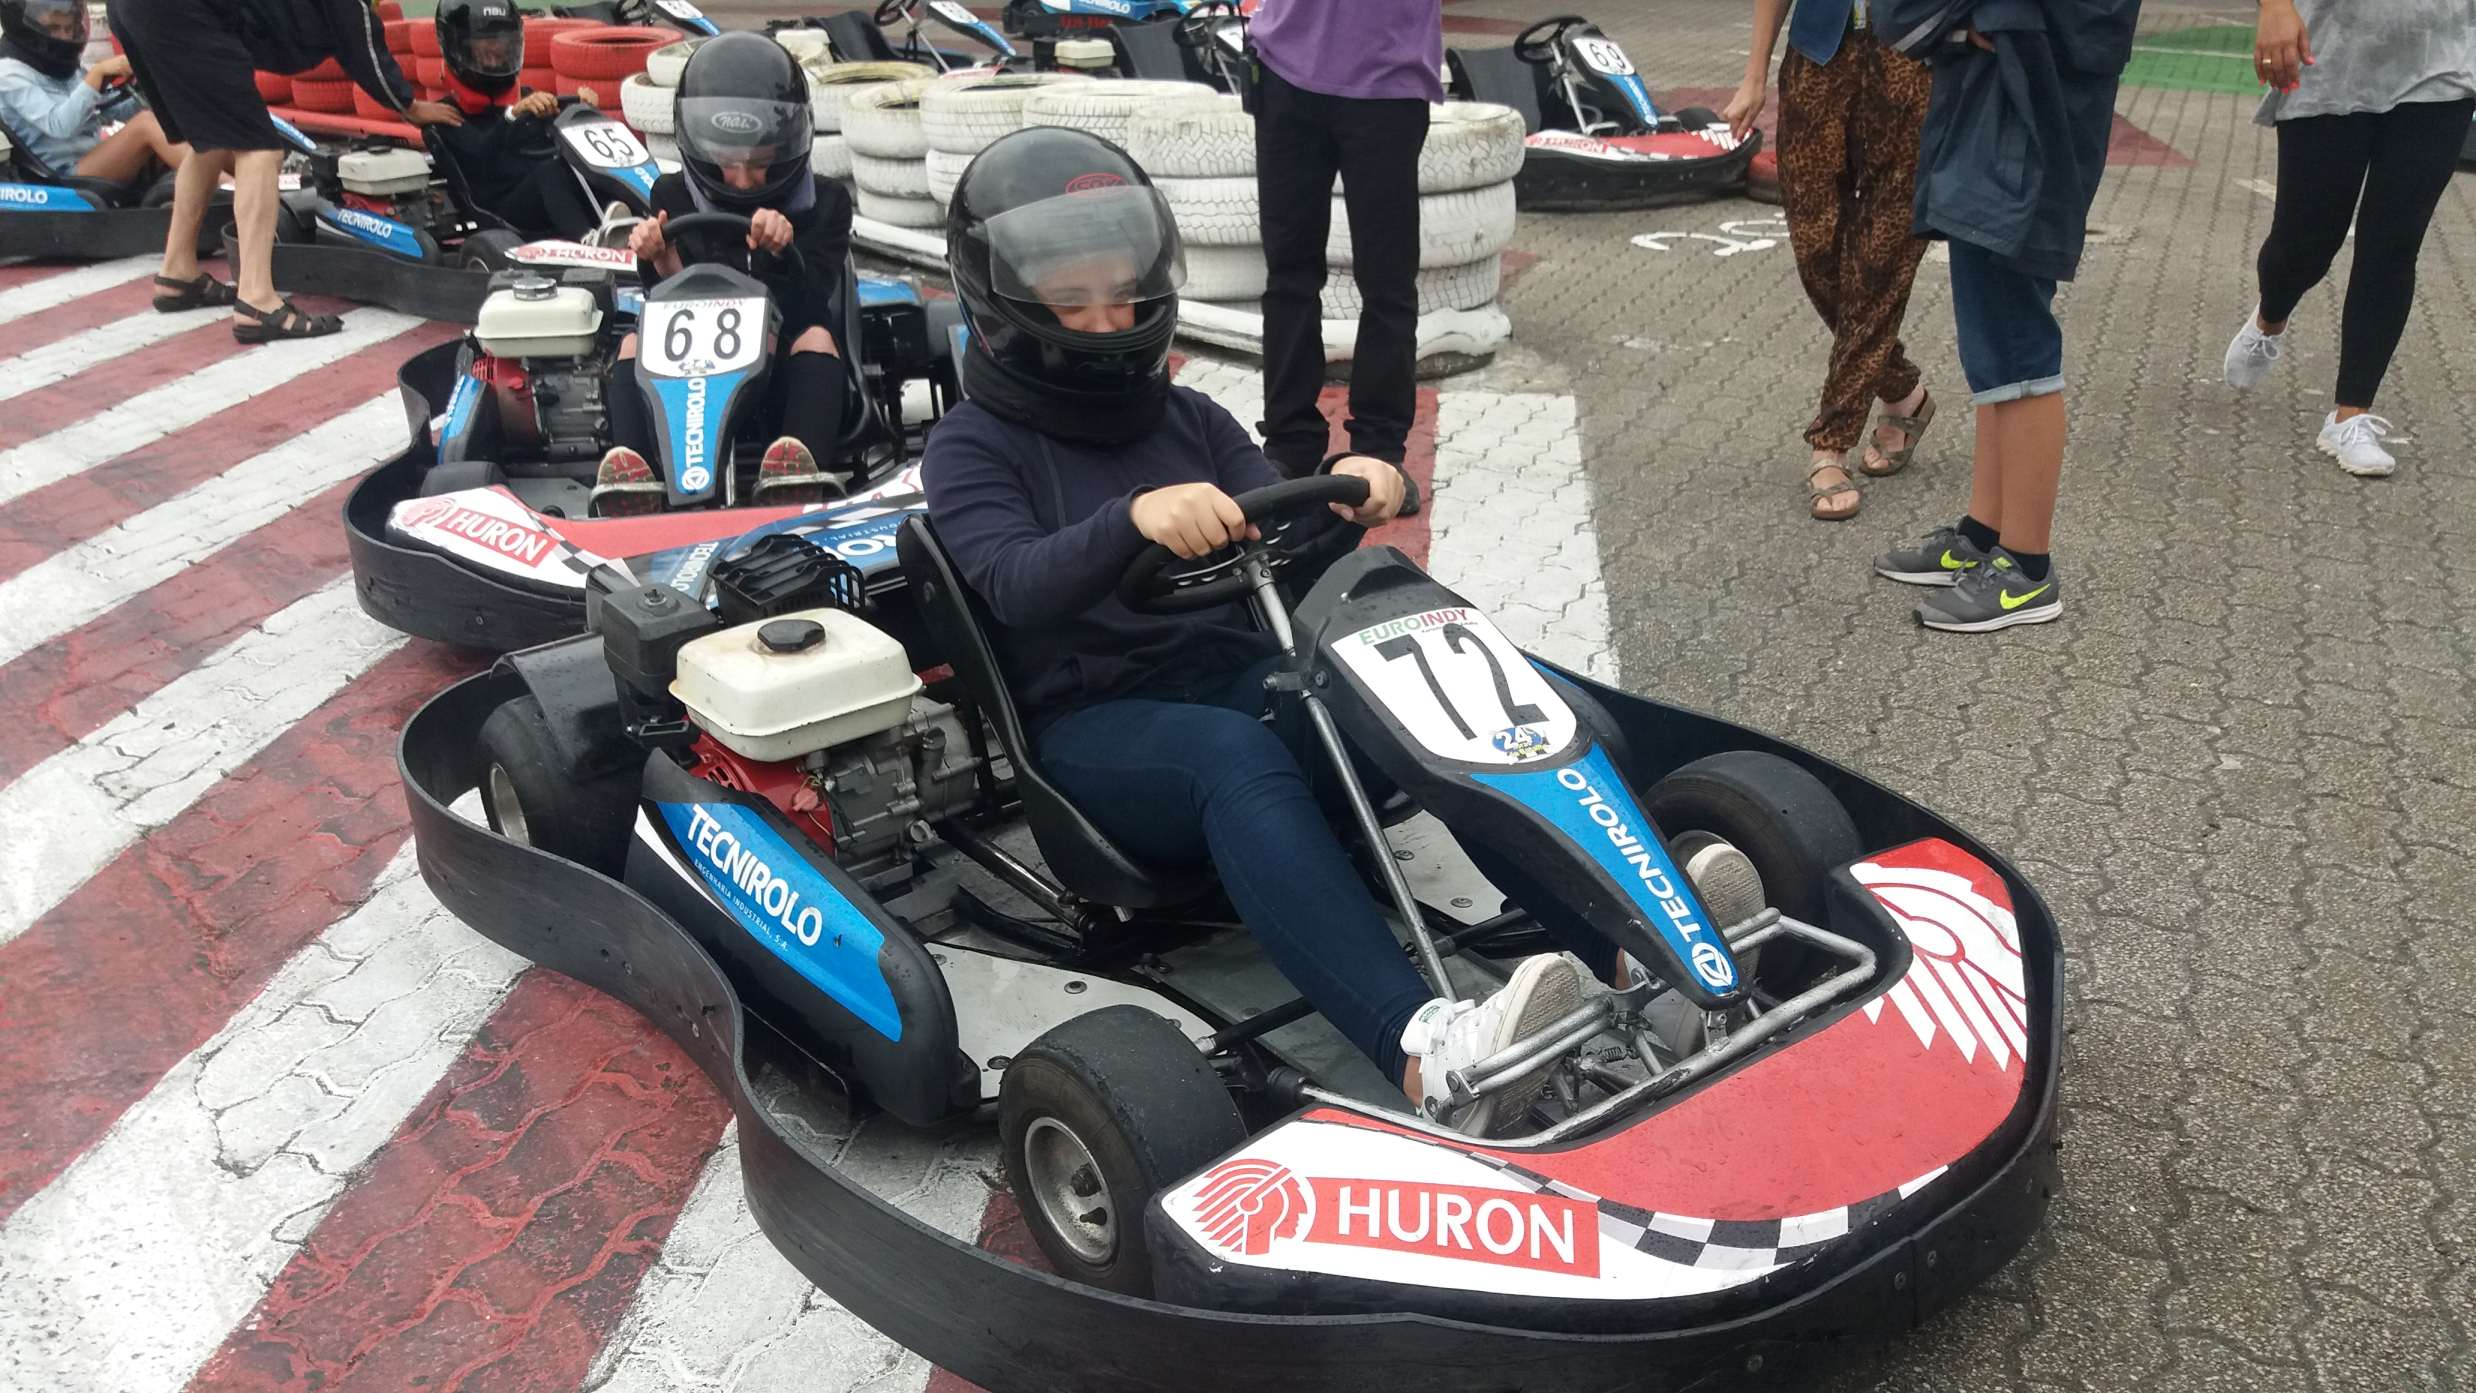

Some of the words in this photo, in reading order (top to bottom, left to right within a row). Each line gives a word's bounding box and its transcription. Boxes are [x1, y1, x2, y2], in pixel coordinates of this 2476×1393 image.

[1589, 43, 1626, 69] 69
[583, 129, 634, 159] 65
[337, 208, 393, 239] TECNIROLO
[556, 248, 627, 264] HURON
[664, 308, 742, 362] 68
[685, 377, 706, 469] TECNIROLO
[447, 511, 549, 562] HURON
[1358, 607, 1469, 646] EUROINDY
[1373, 622, 1550, 742] 72
[687, 803, 823, 947] TECNIROLO
[1556, 768, 1702, 943] TECNIROLO
[1338, 1185, 1576, 1264] HURON
